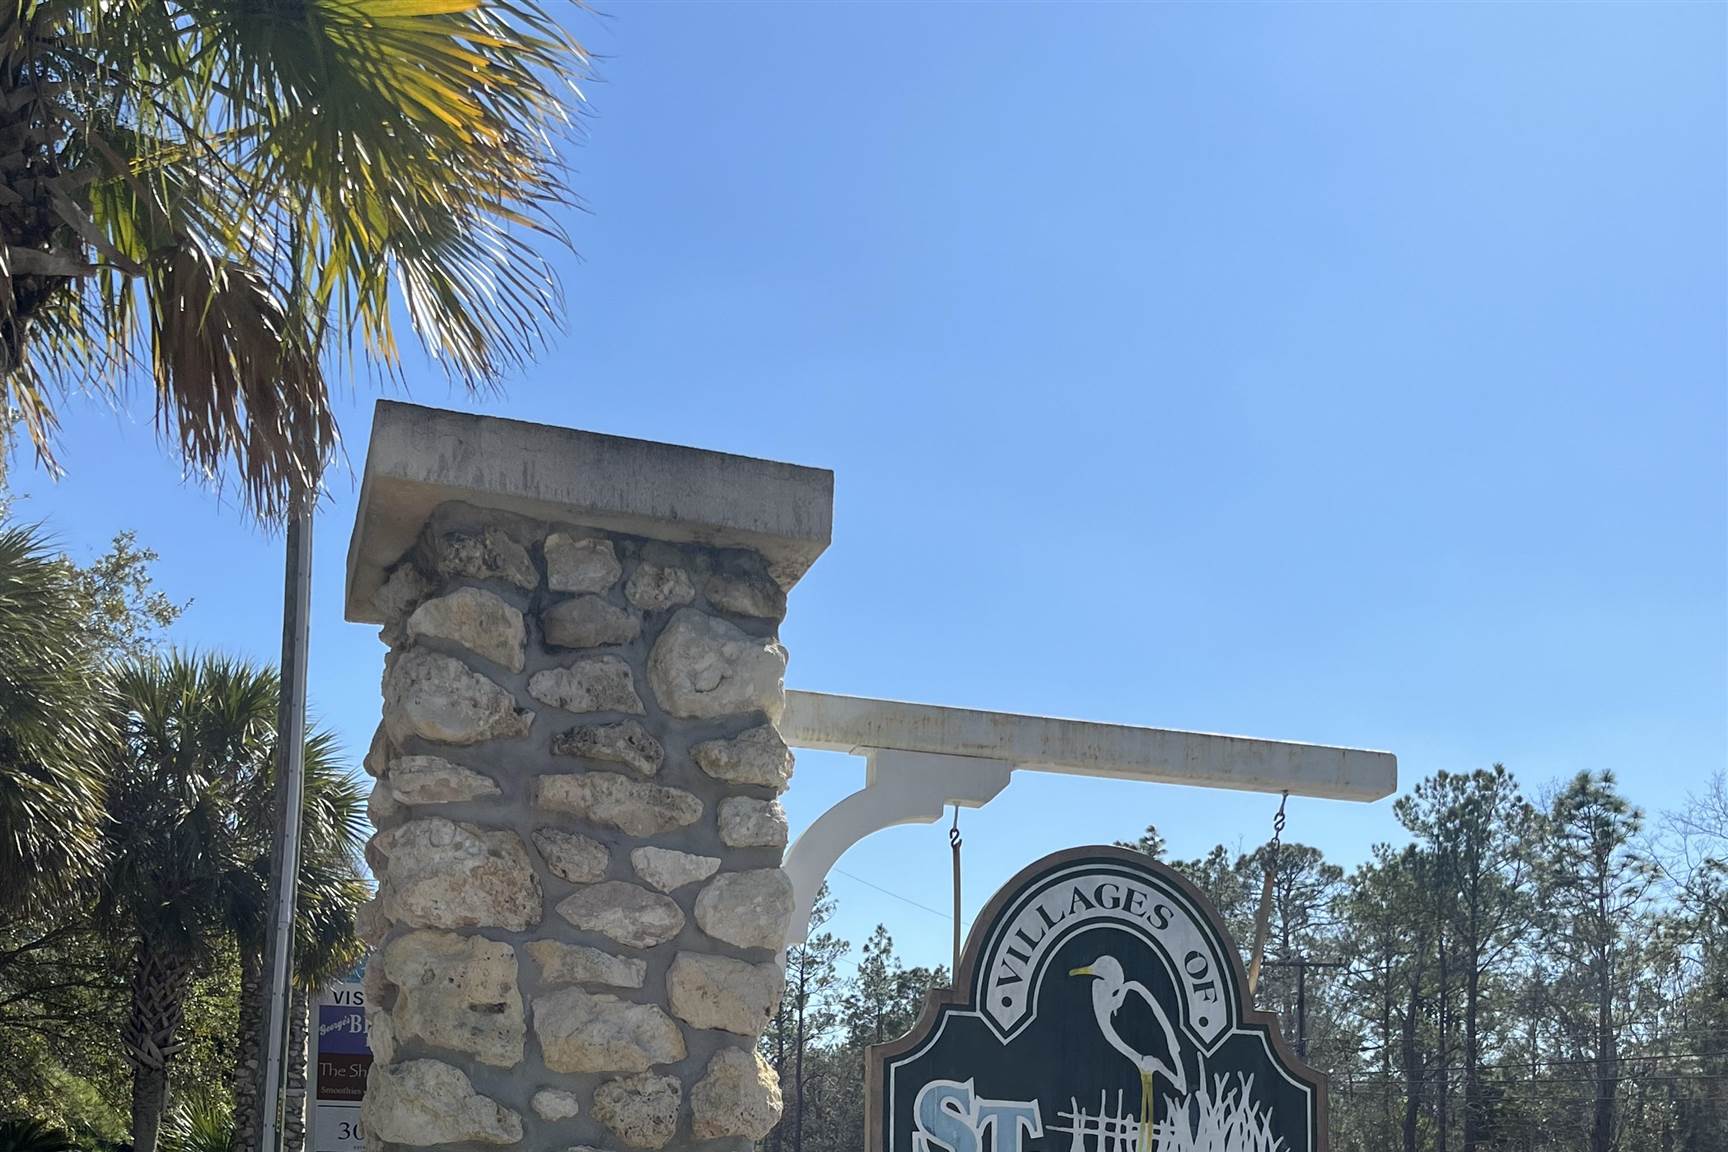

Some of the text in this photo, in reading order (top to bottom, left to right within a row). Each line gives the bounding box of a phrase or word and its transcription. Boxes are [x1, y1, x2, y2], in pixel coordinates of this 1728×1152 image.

[994, 882, 1220, 1005] VILLAGES OF
[319, 1062, 346, 1077] The
